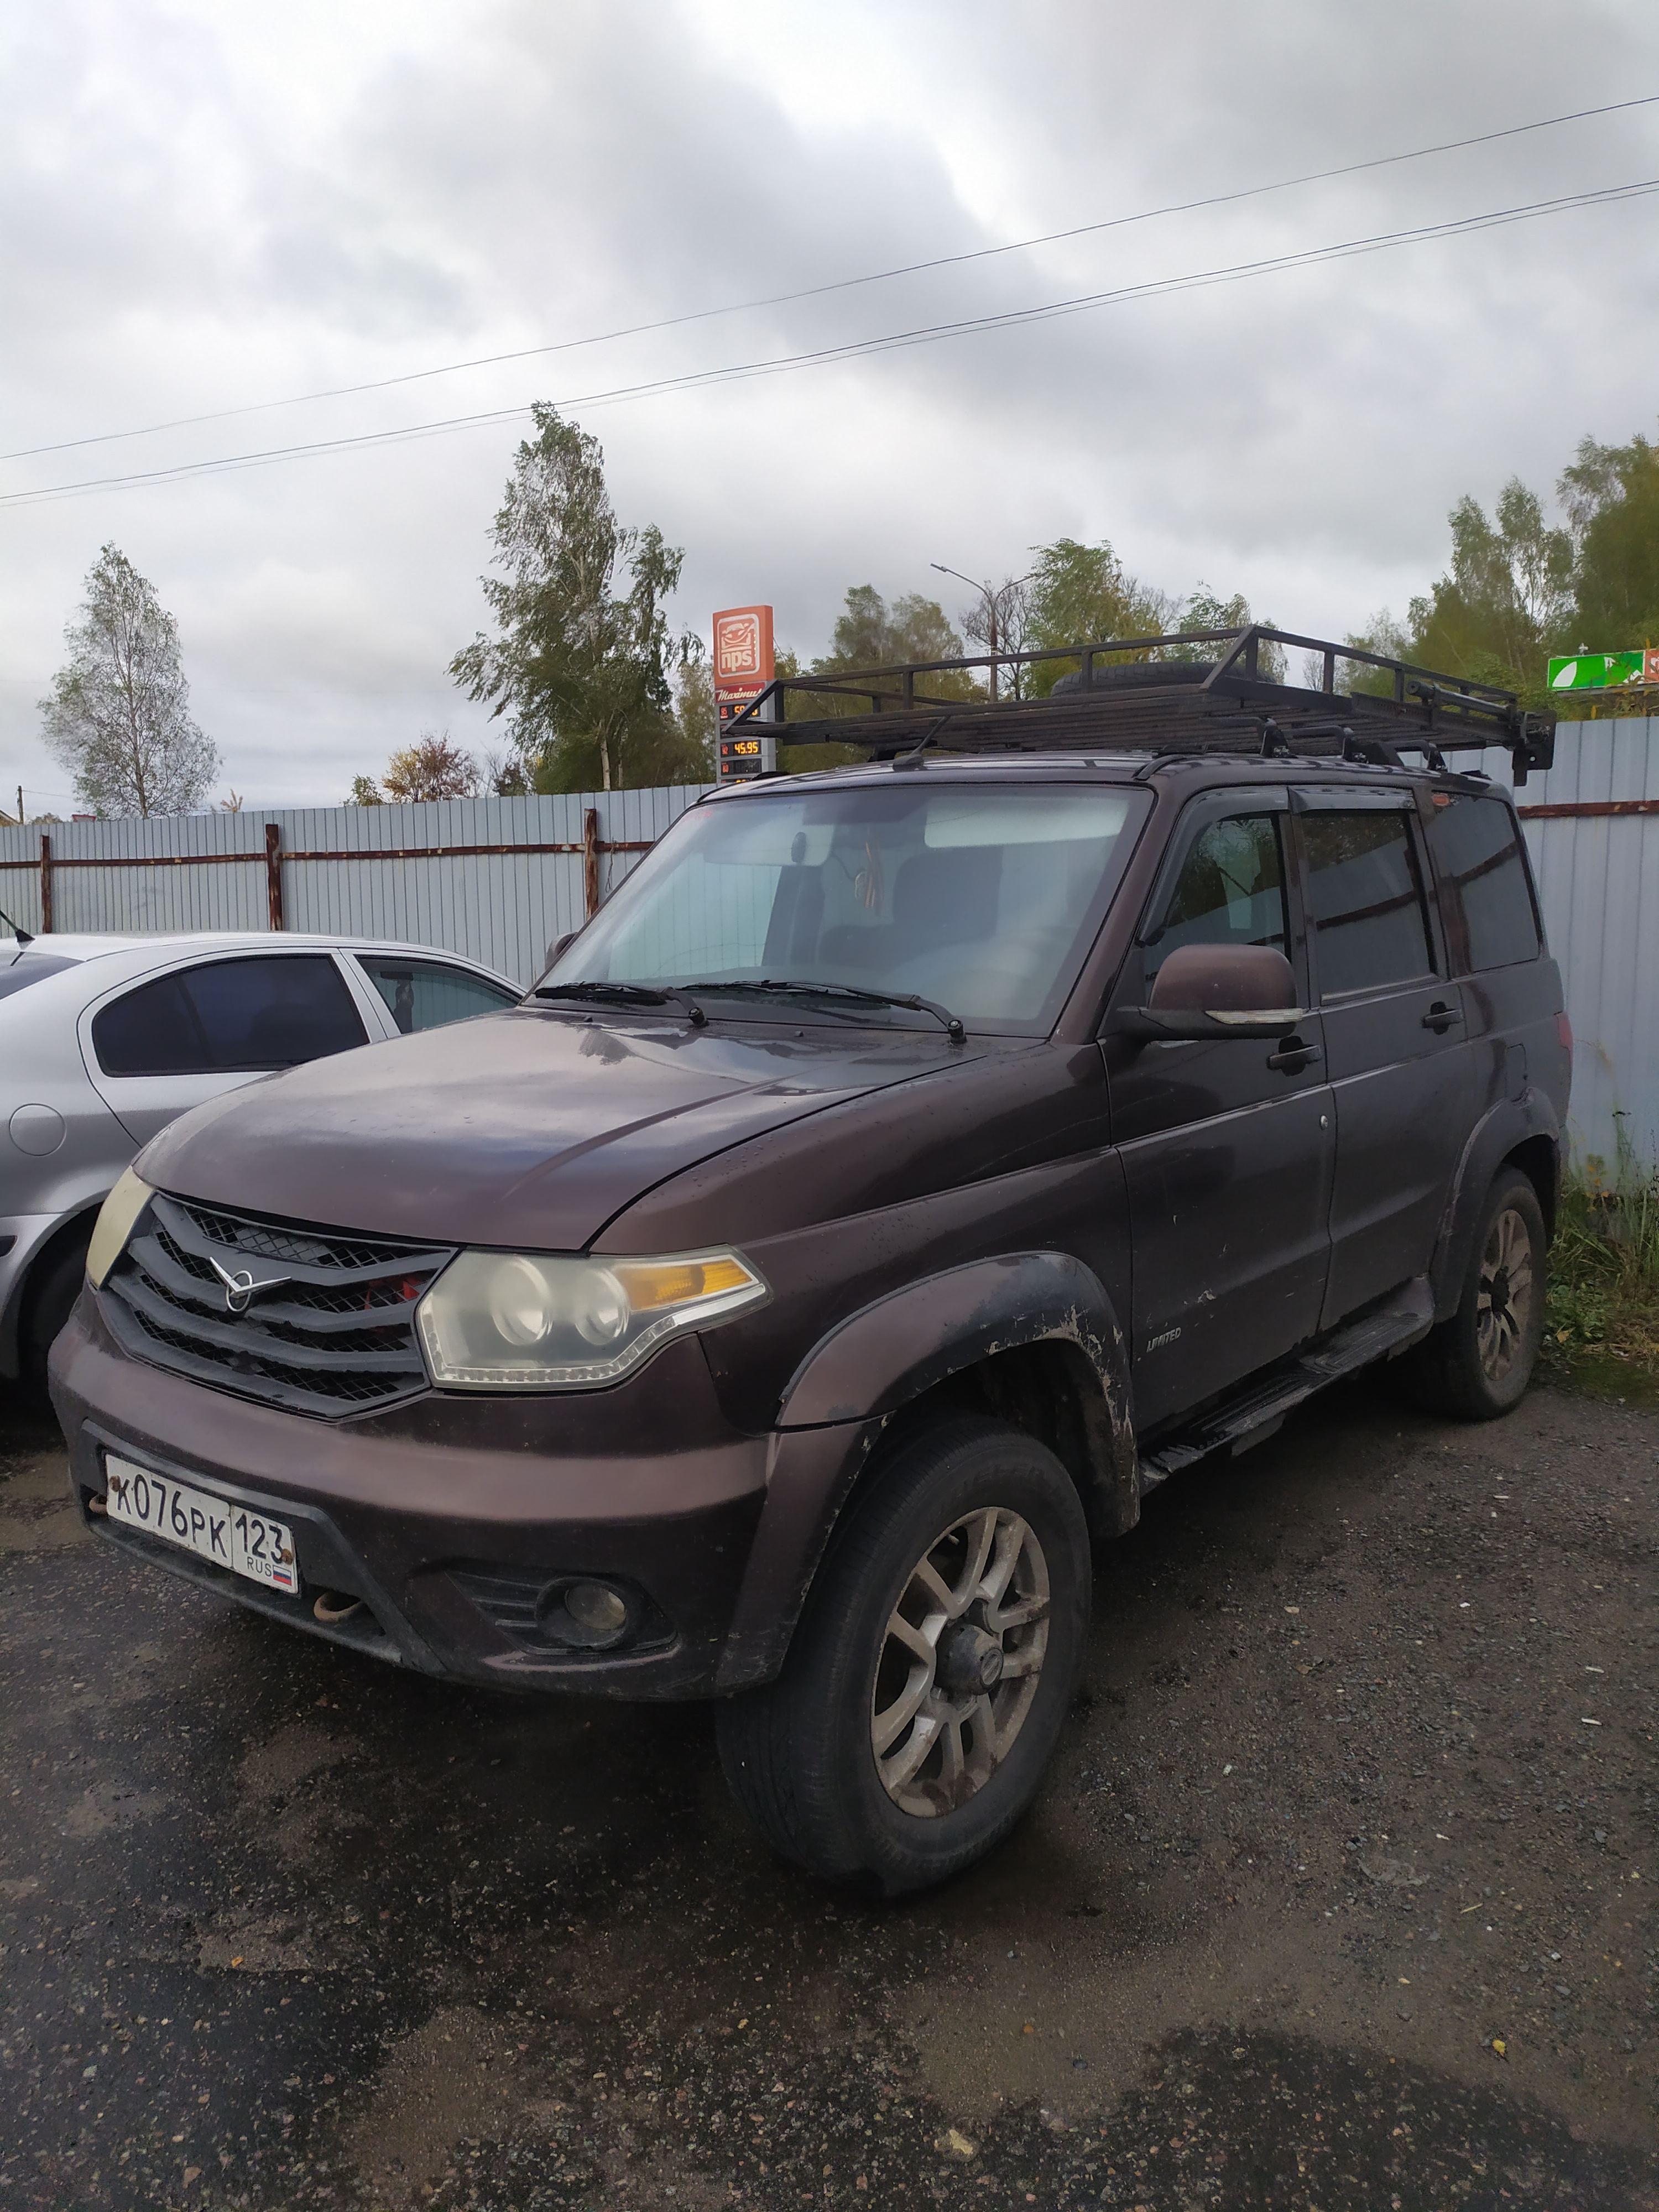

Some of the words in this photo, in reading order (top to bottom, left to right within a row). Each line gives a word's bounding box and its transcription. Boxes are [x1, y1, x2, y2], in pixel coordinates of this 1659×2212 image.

[734, 742, 758, 754] 45.95
[236, 1513, 284, 1564] 123
[247, 1557, 272, 1577] RUS
